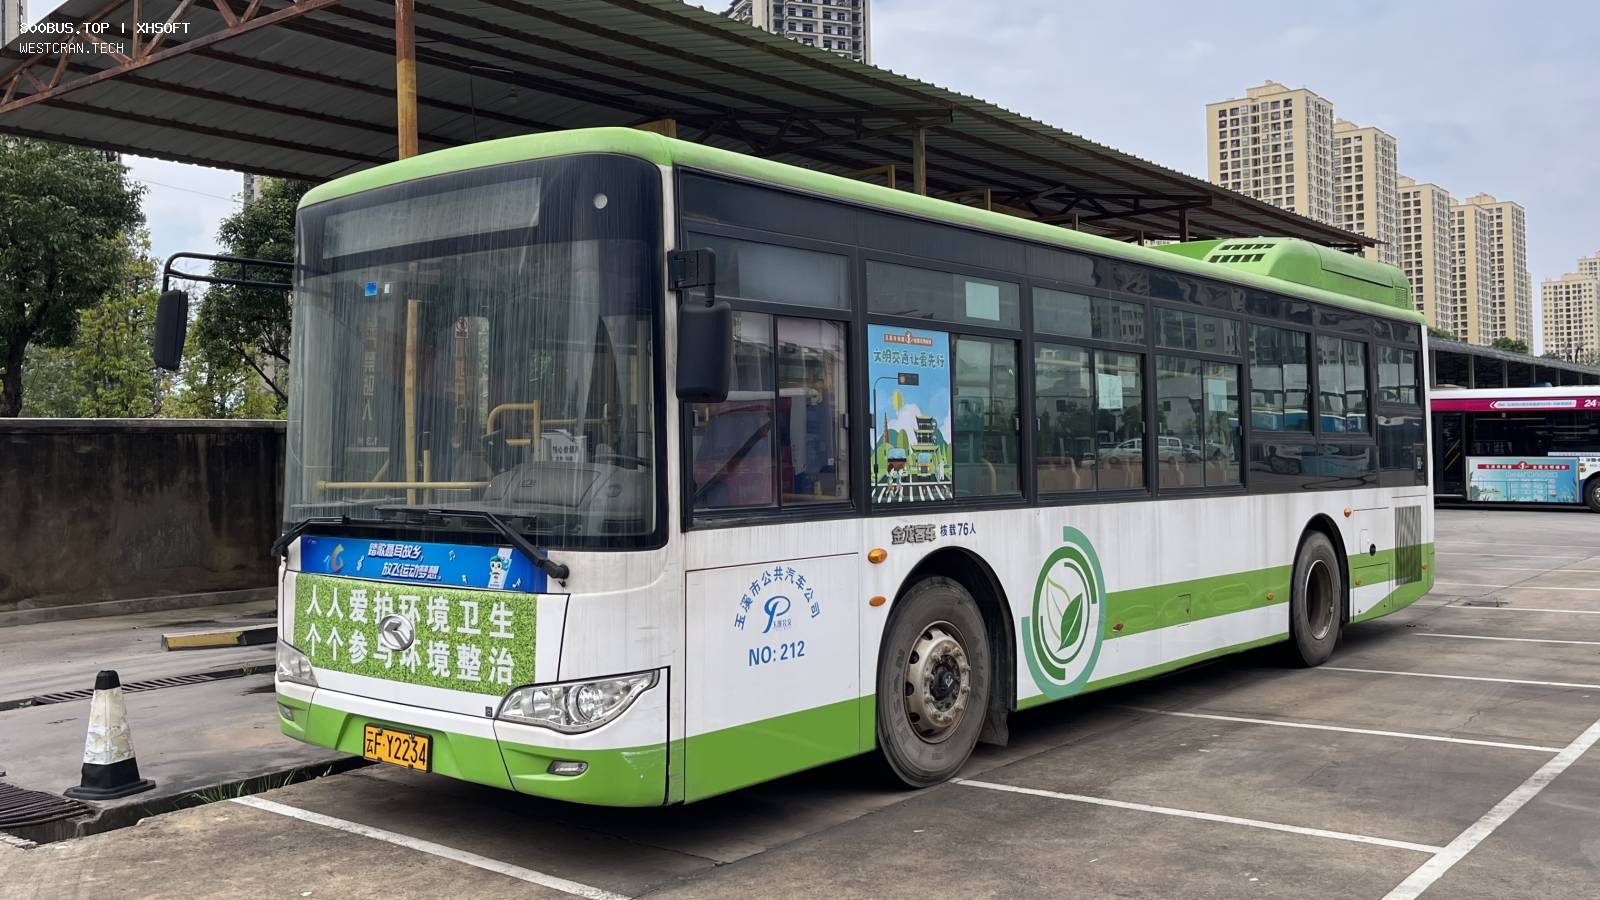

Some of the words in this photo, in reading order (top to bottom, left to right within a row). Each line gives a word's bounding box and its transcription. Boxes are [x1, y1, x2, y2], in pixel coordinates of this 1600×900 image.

[1583, 398, 1600, 409] 24
[892, 523, 937, 545] 金龙客车
[306, 584, 515, 639] 人人爱护环境卫生
[734, 565, 821, 631] 玉溪市公共汽车公司
